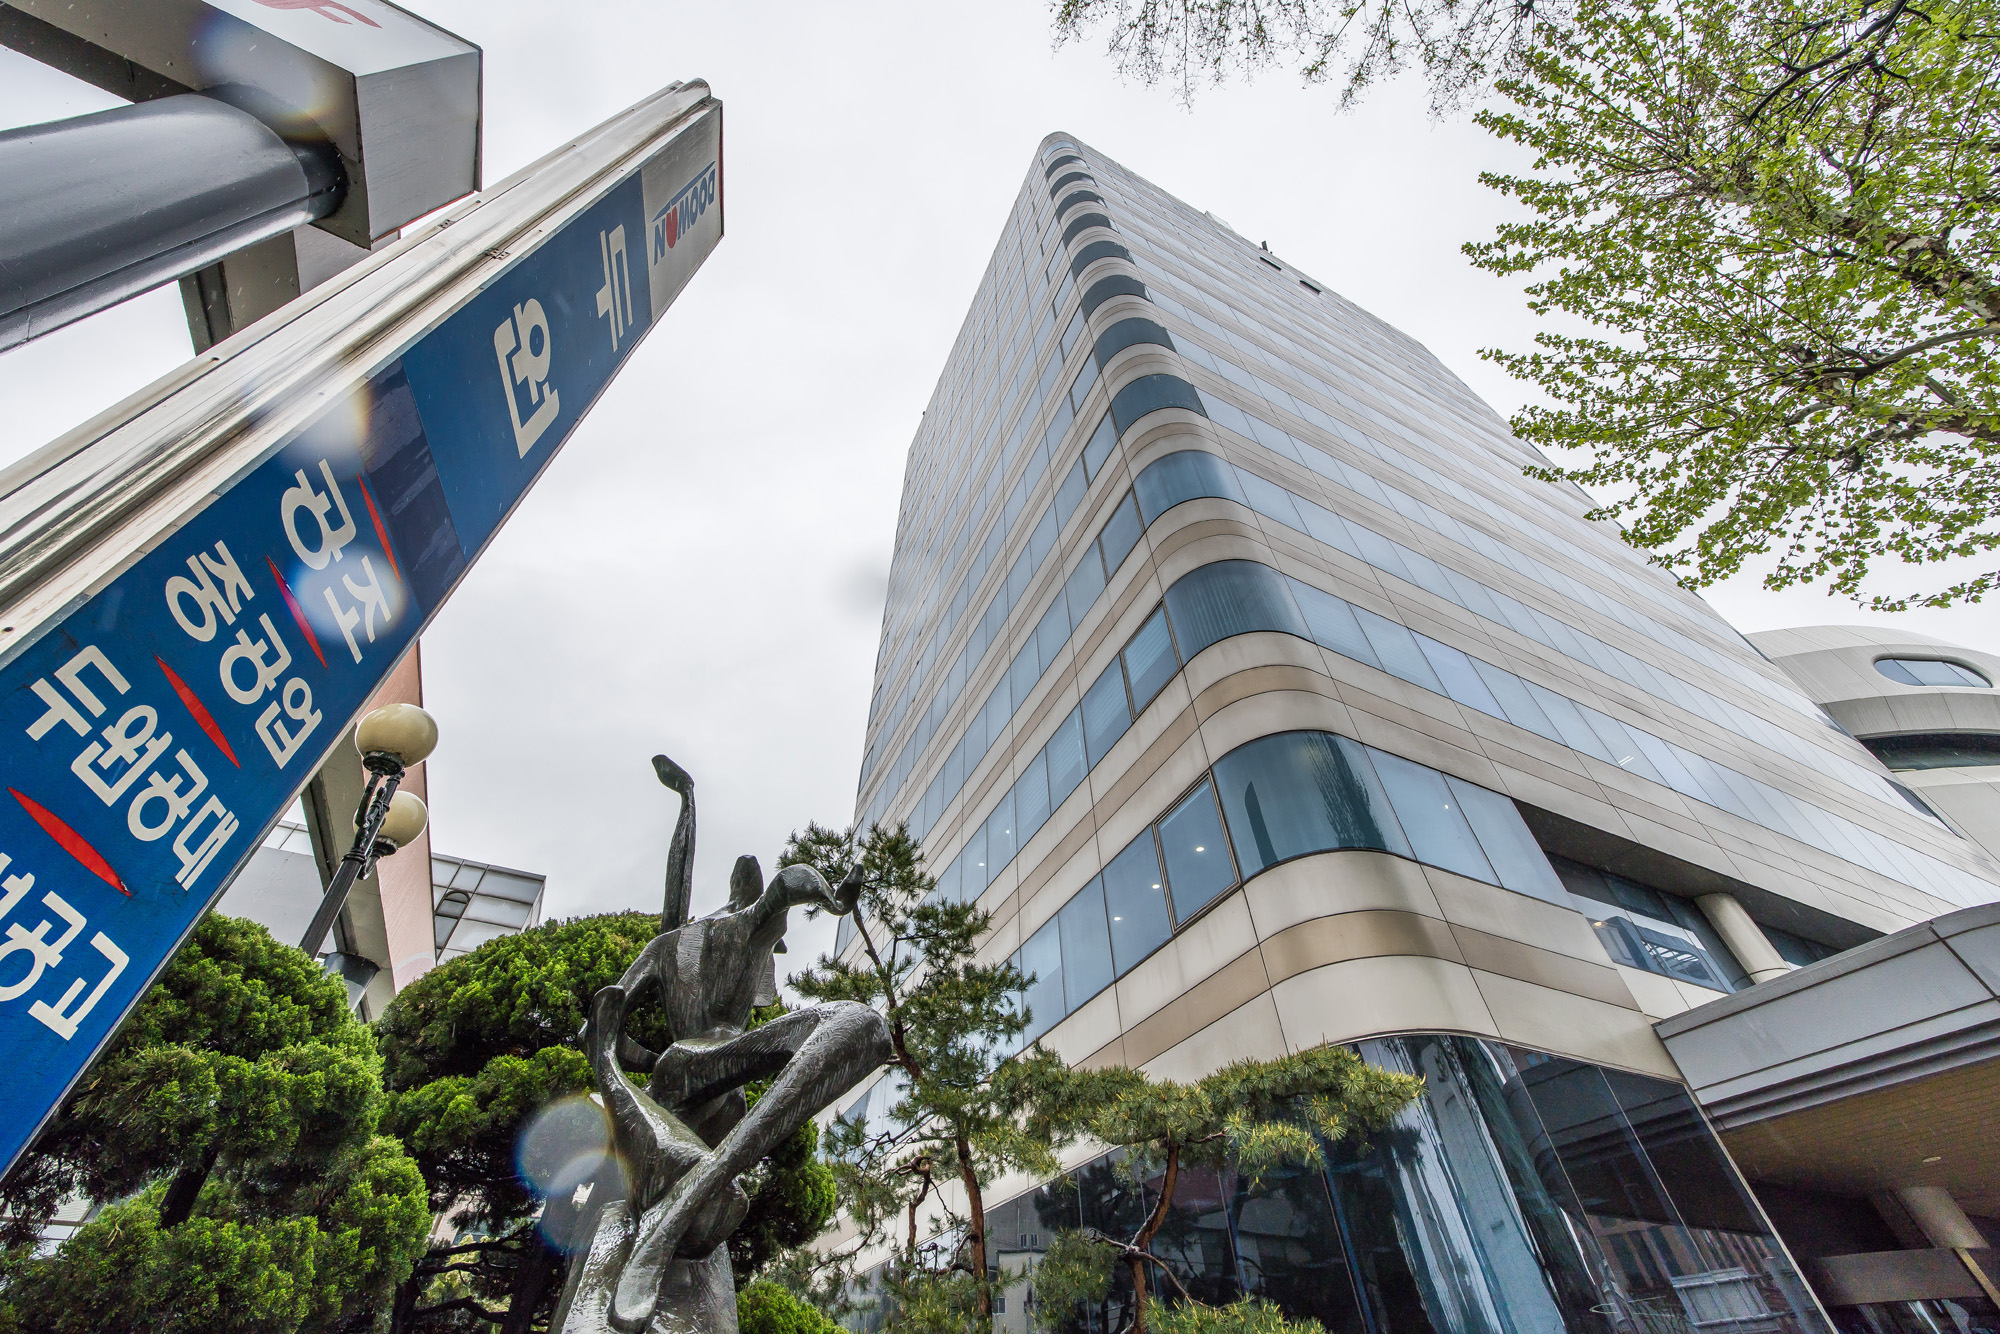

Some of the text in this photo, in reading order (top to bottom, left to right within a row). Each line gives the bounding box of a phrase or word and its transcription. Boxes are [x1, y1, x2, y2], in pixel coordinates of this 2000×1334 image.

[653, 167, 716, 267] DOOWON
[165, 540, 323, 770] 중공업
[280, 458, 392, 665] 공조
[26, 645, 240, 892] 두원공대
